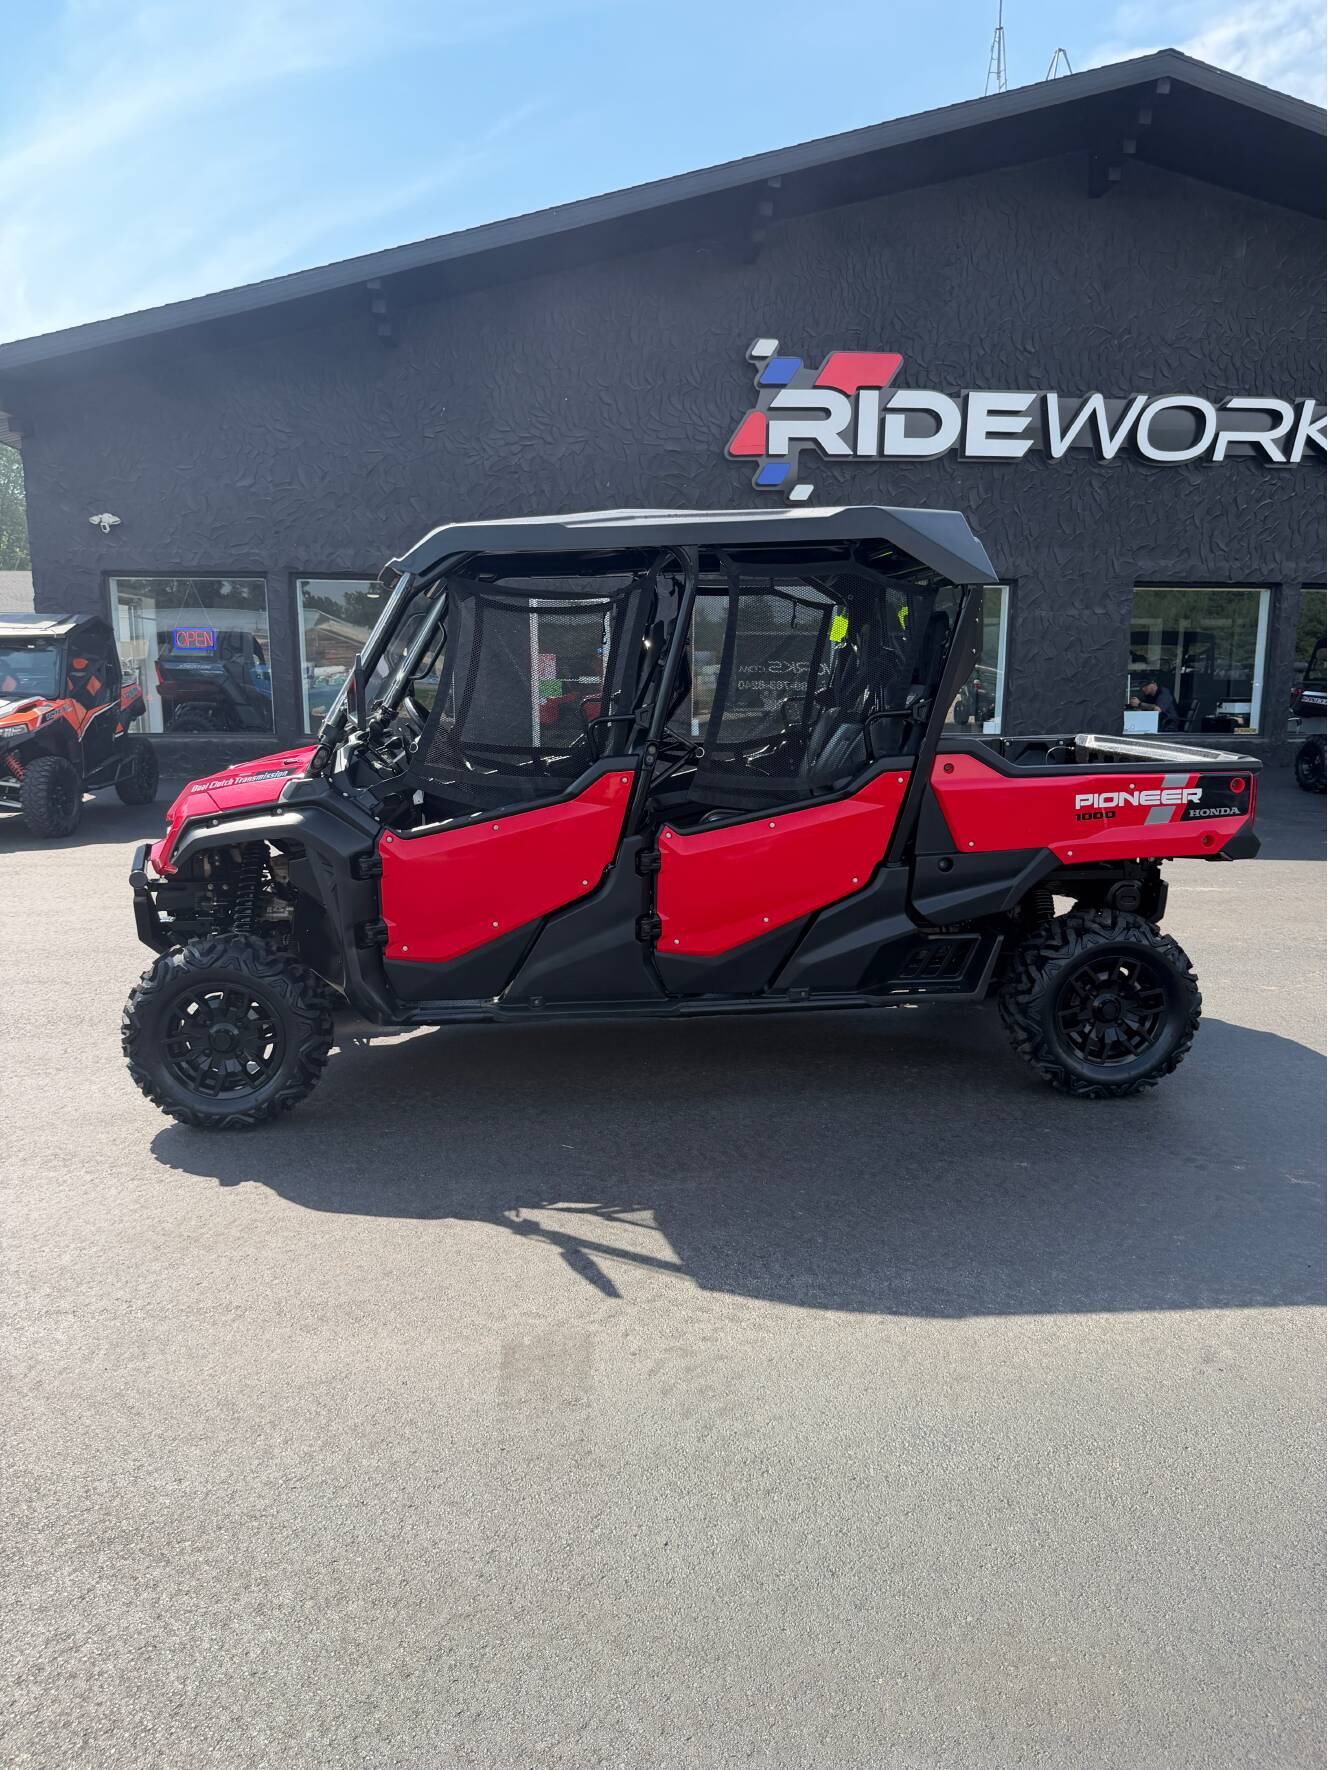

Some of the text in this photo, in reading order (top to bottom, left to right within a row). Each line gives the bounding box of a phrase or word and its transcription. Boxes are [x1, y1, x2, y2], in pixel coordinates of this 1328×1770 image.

[176, 631, 214, 647] OPEN
[191, 770, 288, 792] Dual Clutch Transmission
[1075, 788, 1202, 810] PIONEER
[1075, 810, 1116, 822] 1000
[1188, 807, 1241, 817] HONDA
